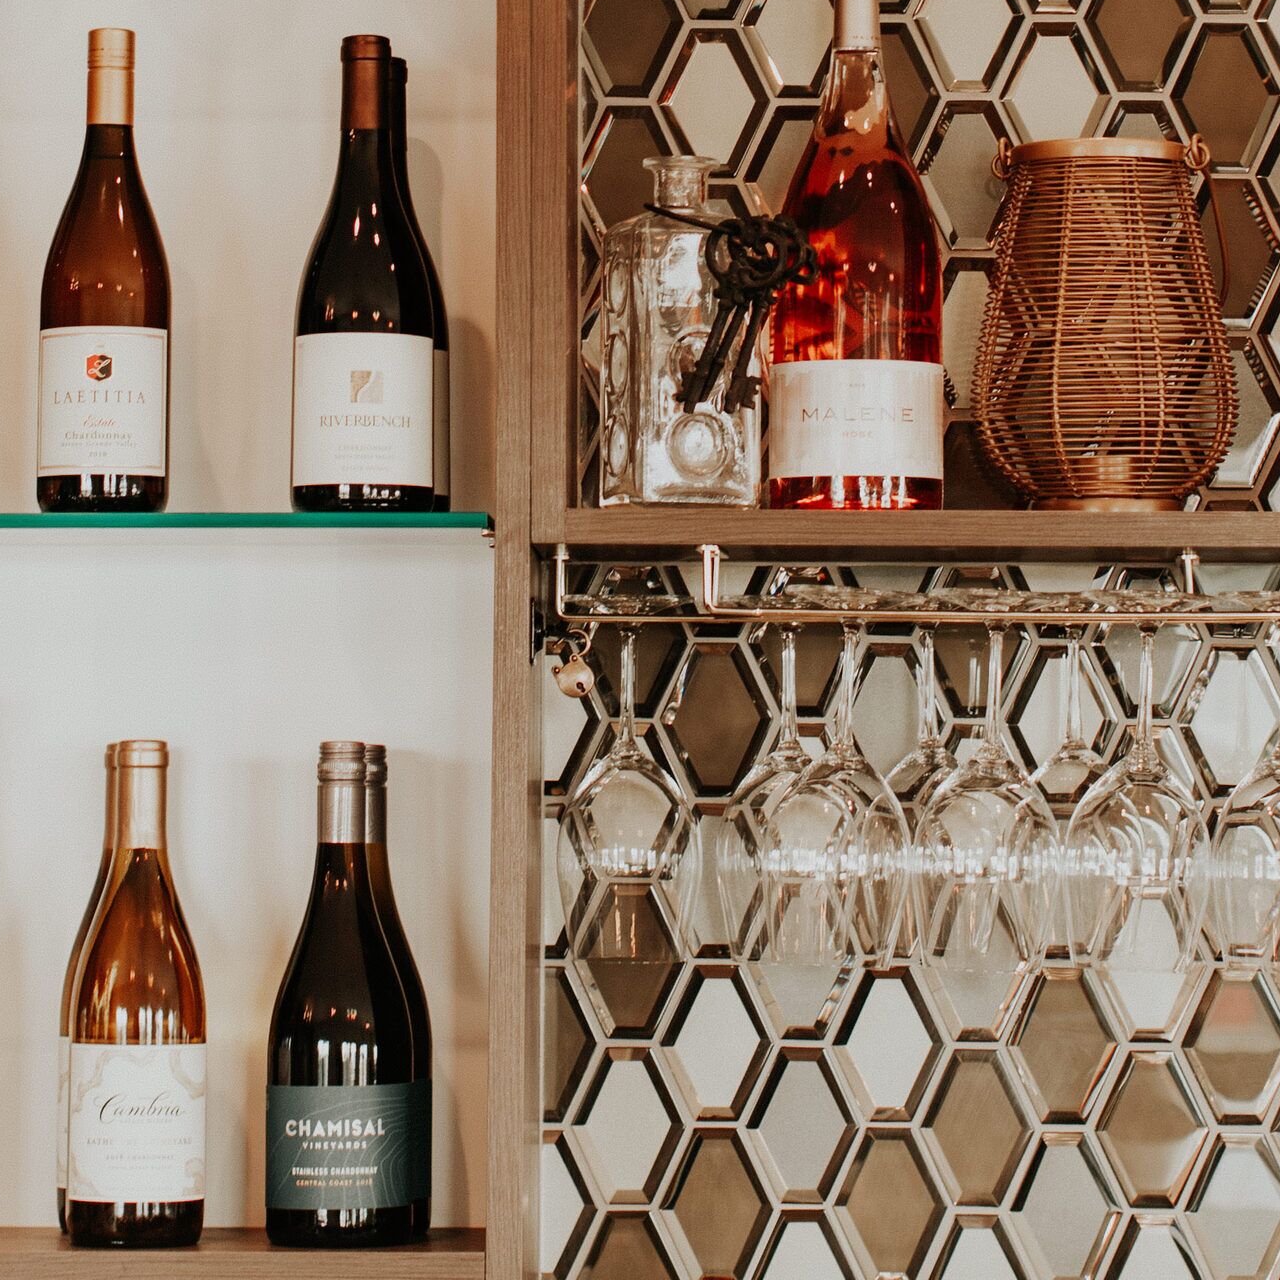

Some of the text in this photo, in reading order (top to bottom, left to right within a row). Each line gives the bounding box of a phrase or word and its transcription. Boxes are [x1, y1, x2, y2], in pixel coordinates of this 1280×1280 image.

[53, 390, 146, 405] LAETITIA
[802, 406, 915, 423] MALENE
[319, 415, 411, 429] RIVERBENCH
[64, 430, 133, 441] Chardonnay
[94, 1091, 189, 1125] Cambria
[285, 1118, 386, 1138] CHAMISAL
[302, 1141, 368, 1151] VINEYARDS
[291, 1166, 379, 1177] STAINLESS CHARDONNAY
[296, 1179, 326, 1187] CENTRAL
[328, 1179, 354, 1187] COAST
